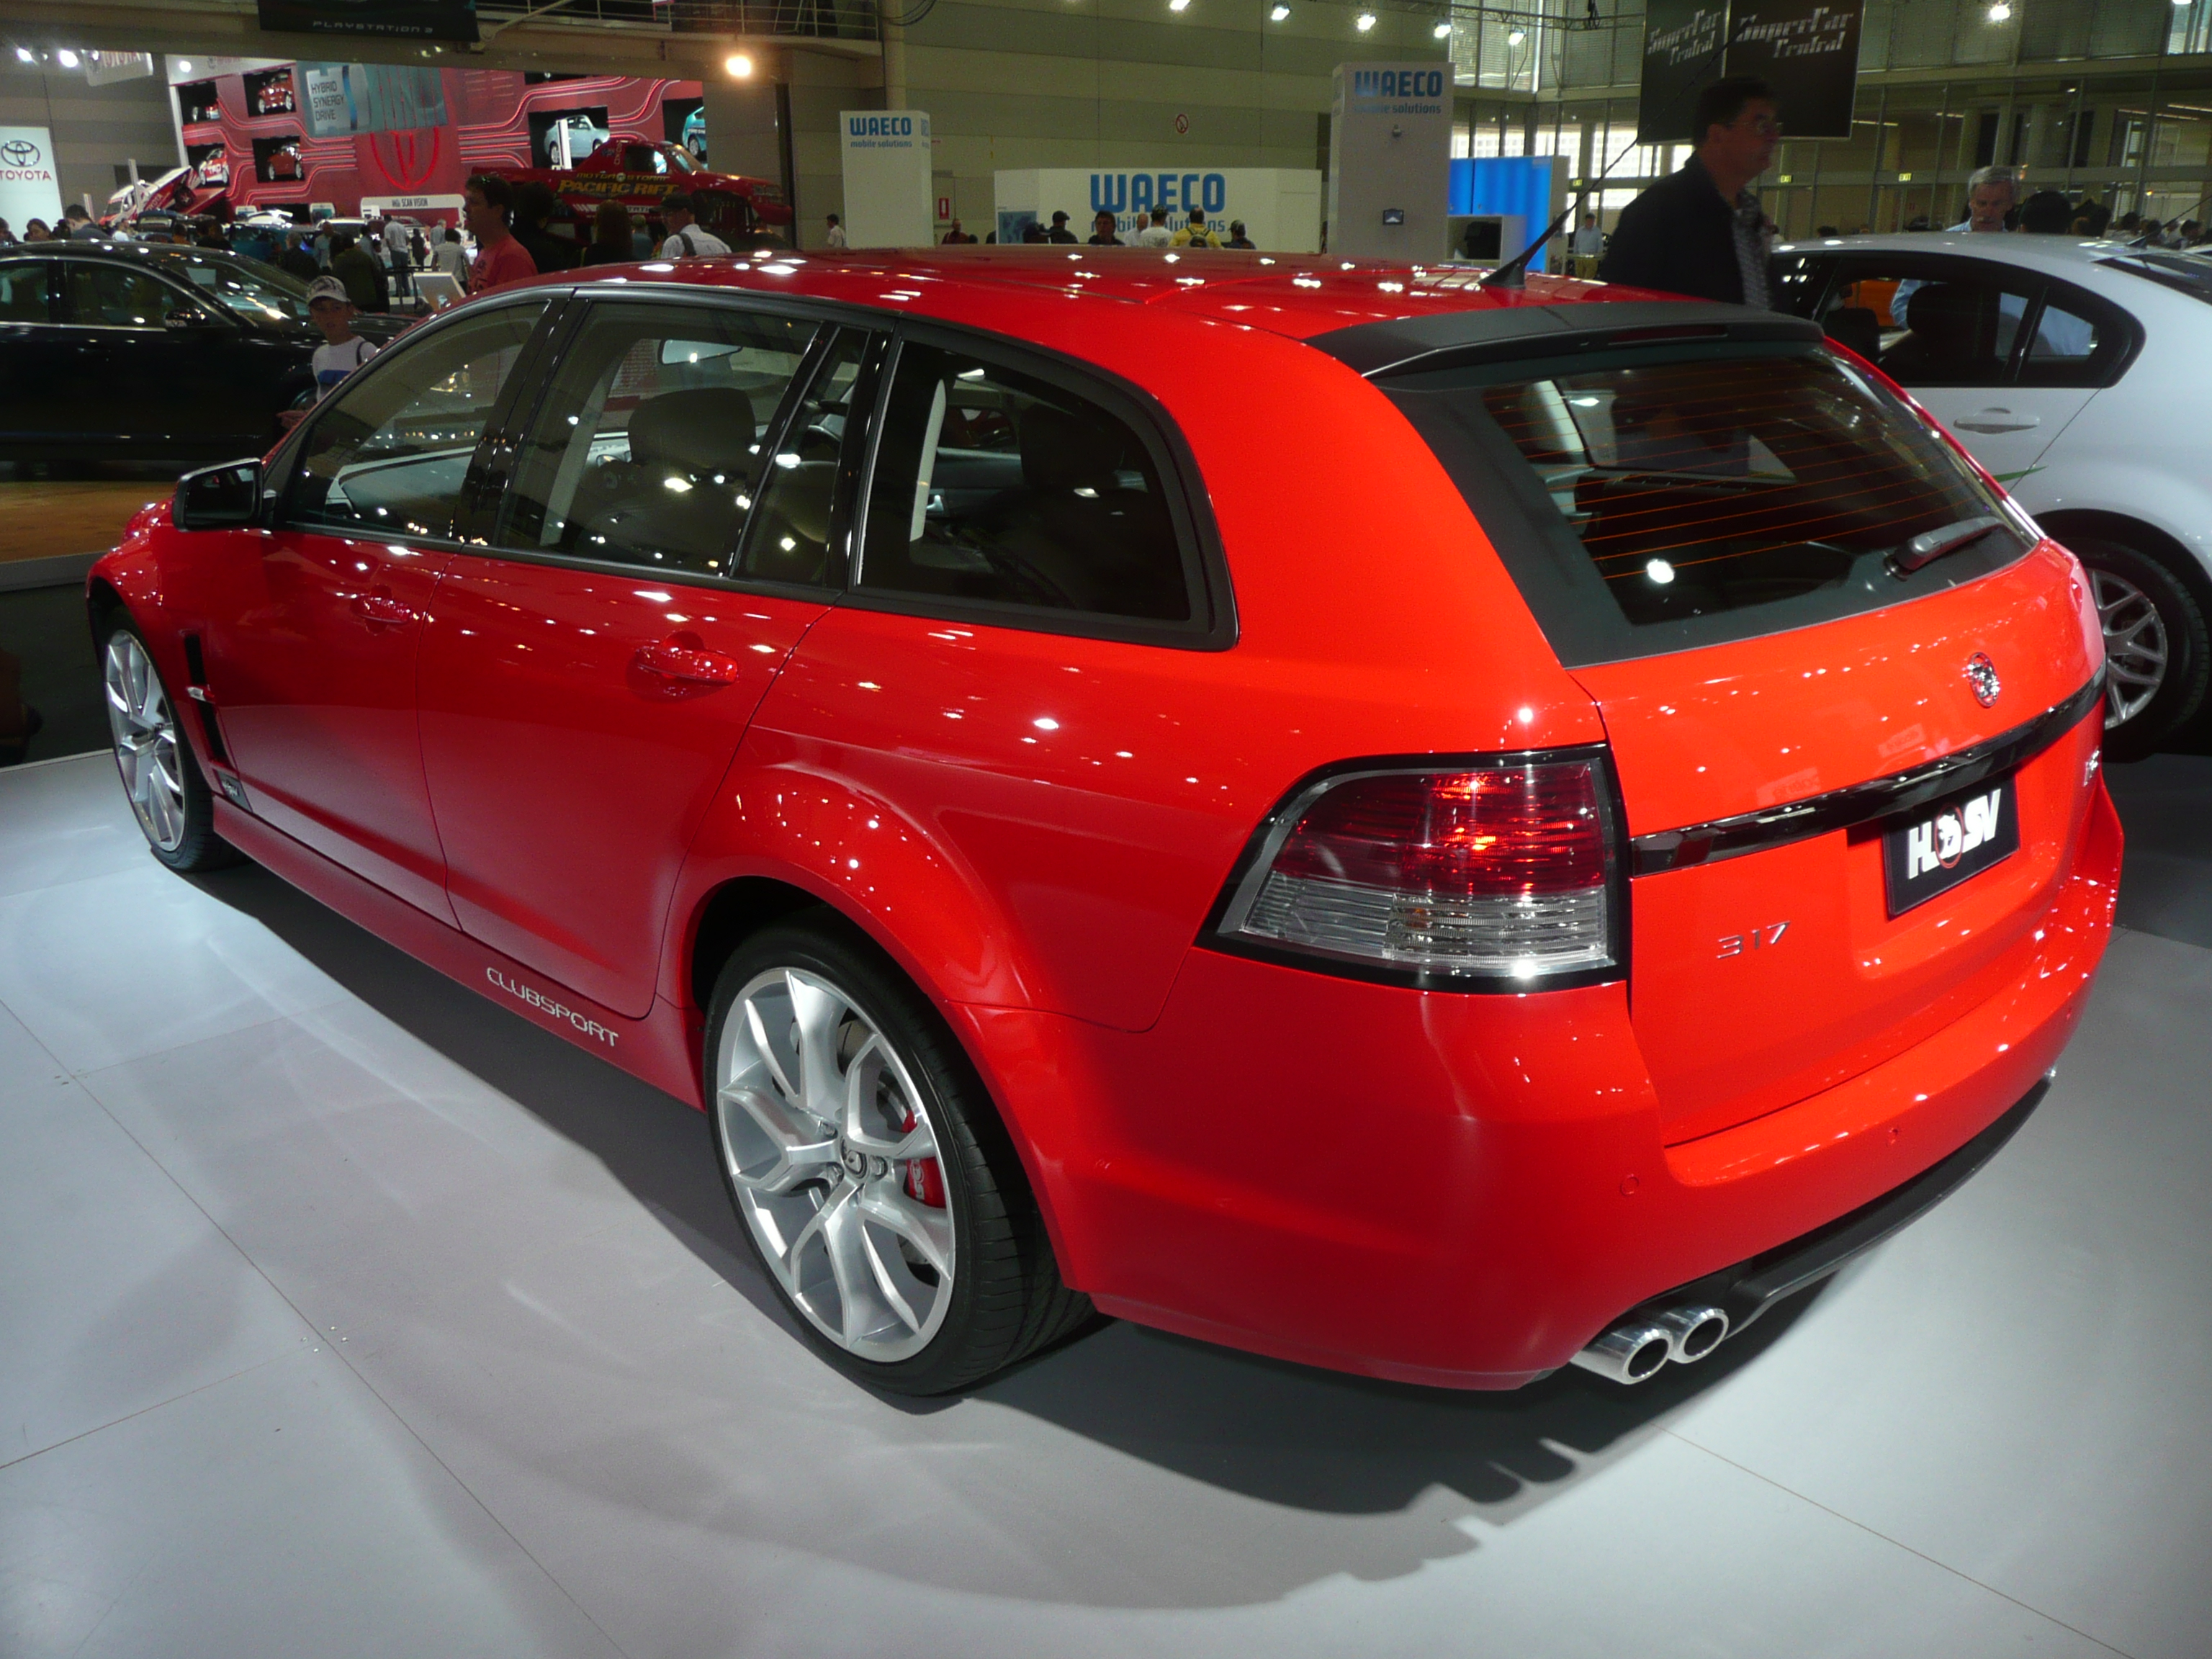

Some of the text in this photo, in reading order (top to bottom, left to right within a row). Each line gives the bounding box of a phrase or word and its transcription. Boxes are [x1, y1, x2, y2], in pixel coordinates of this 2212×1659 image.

[311, 81, 337, 94] HYBRID
[1355, 71, 1443, 97] WAECO
[313, 94, 344, 108] SYNERGY
[1392, 103, 1442, 114] solutions
[315, 109, 336, 121] DRIVE
[850, 117, 912, 136] WAECO
[0, 169, 51, 181] TOYOTA
[557, 180, 680, 196] PACIFIC RIFT
[1090, 173, 1226, 213] WAECO
[1717, 920, 1791, 959] 317
[486, 967, 619, 1046] CLUBSPORT
